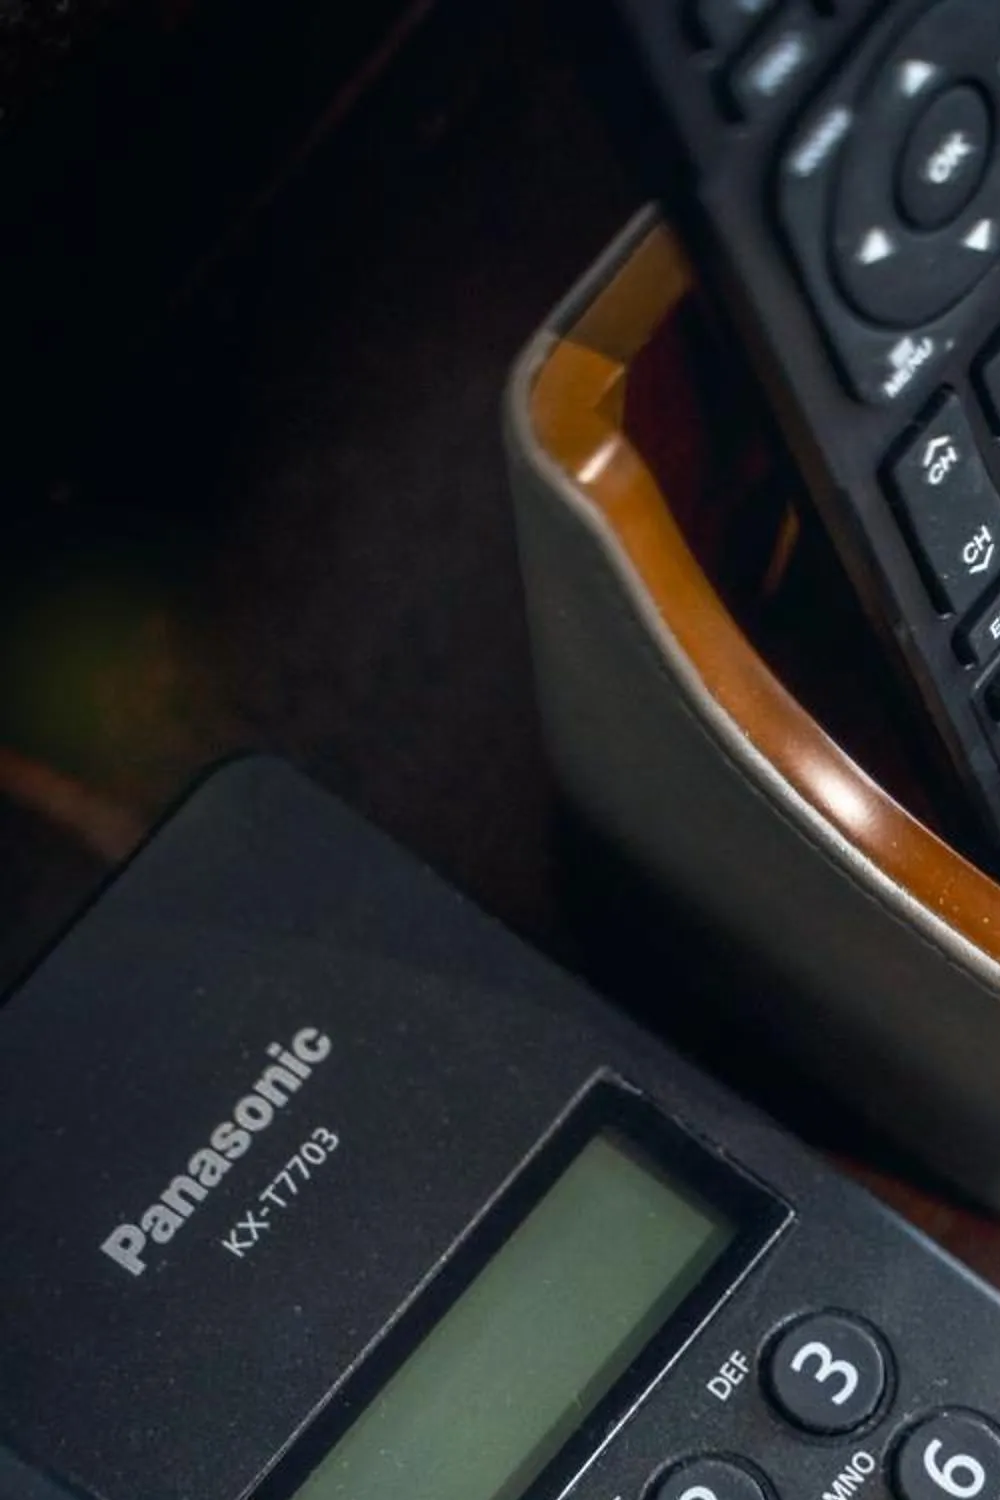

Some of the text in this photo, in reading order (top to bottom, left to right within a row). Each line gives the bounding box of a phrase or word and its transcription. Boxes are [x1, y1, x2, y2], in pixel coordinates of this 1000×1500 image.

[928, 133, 971, 184] OK
[883, 337, 933, 398] MENU
[927, 448, 959, 485] CH
[962, 525, 993, 565] CH
[100, 1027, 331, 1276] Panasonic
[221, 1127, 339, 1258] KX-T7703
[706, 1349, 749, 1401] DEF
[790, 1341, 859, 1405] 3
[923, 1439, 986, 1499] 6
